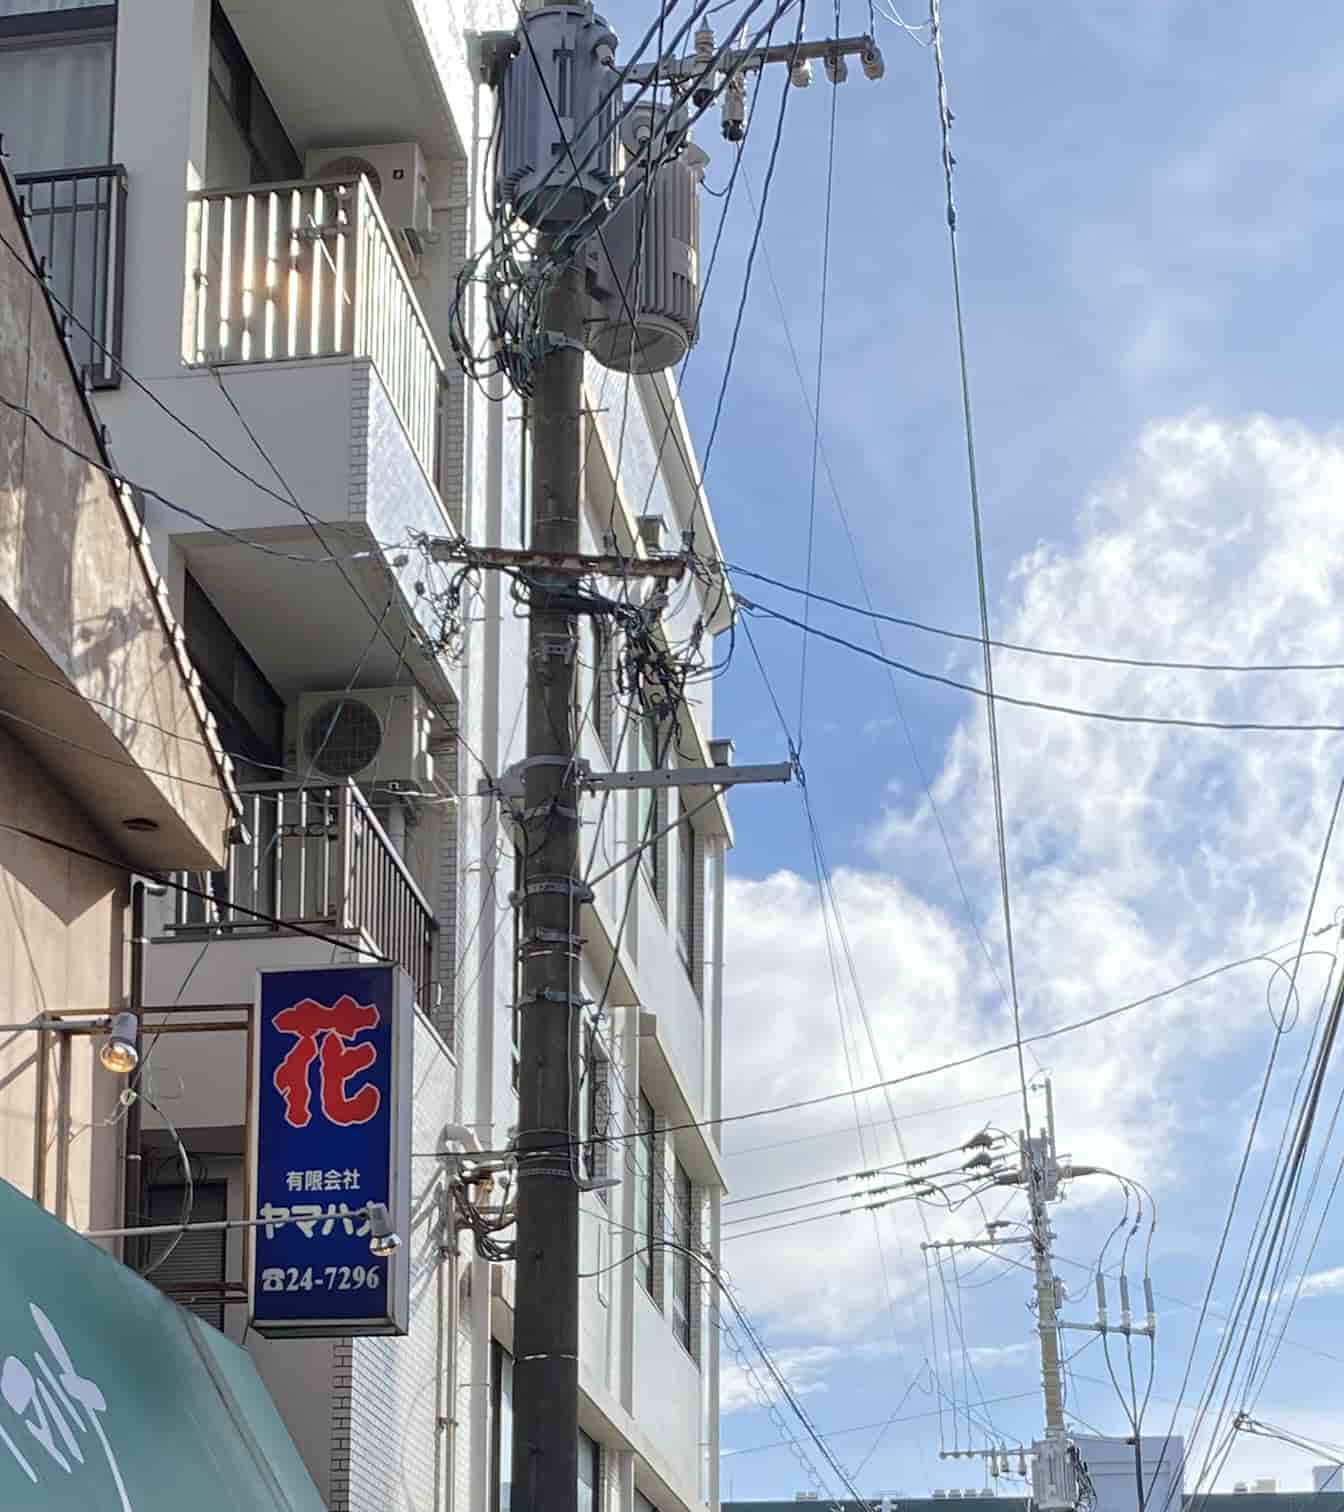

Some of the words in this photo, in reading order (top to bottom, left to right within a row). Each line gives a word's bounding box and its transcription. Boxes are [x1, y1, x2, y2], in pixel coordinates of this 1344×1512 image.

[272, 995, 380, 1128] 花
[286, 1168, 361, 1192] 有限会社
